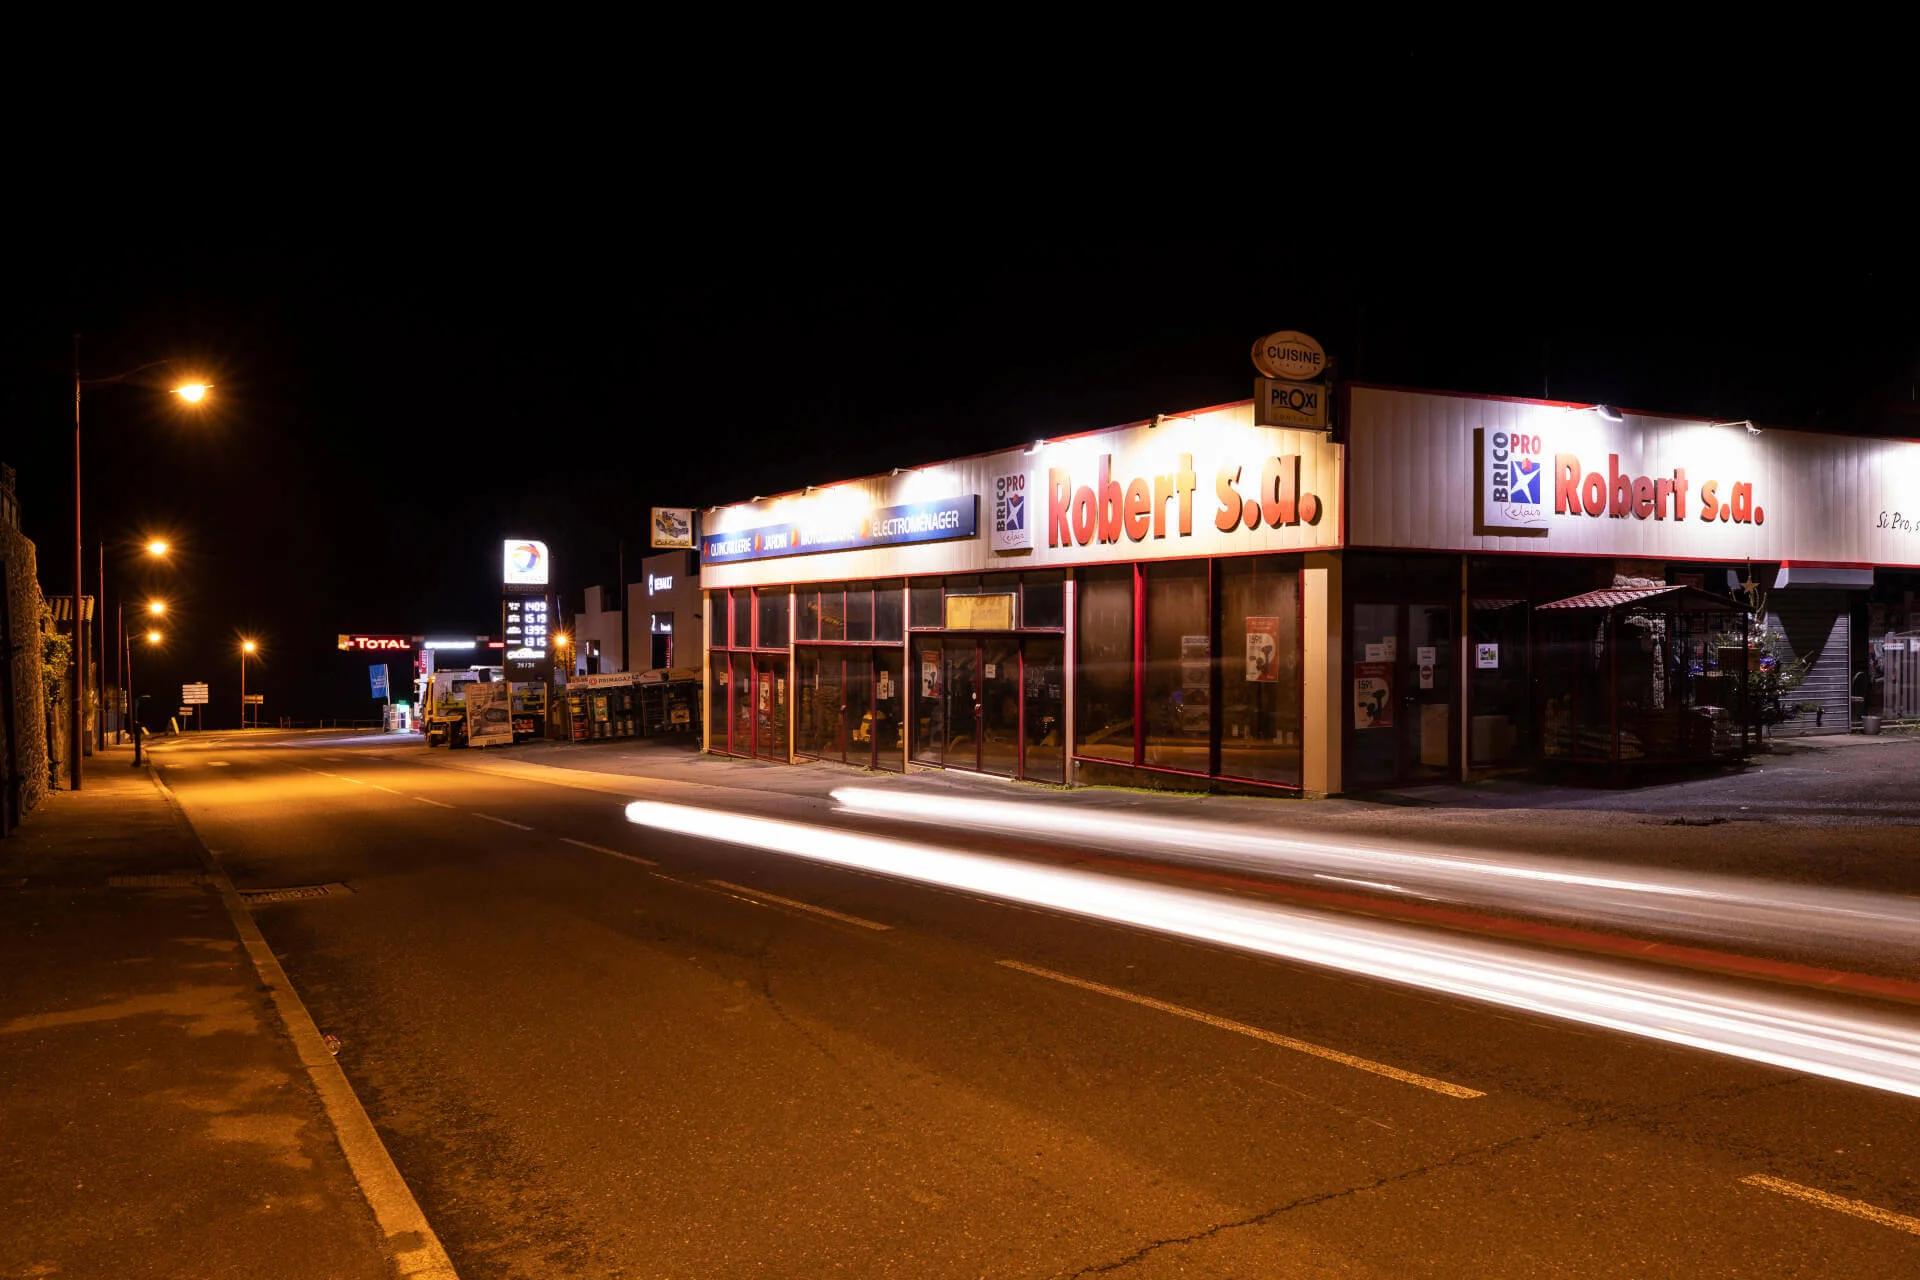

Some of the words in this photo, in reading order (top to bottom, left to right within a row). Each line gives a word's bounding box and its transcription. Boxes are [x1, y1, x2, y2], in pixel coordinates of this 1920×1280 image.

[1267, 346, 1321, 365] CUISINE
[1271, 388, 1318, 410] PROXI
[1510, 433, 1542, 455] PRO
[1493, 432, 1508, 502] BRICO
[1006, 474, 1025, 492] PRO
[1554, 453, 1689, 522] Robert
[1701, 480, 1765, 525] s.a.
[997, 477, 1006, 532] BRICO
[1048, 453, 1197, 548] Robert
[1214, 454, 1323, 533] s.a.
[1876, 511, 1890, 529] Si
[1891, 511, 1912, 533] Pro,
[763, 532, 787, 550] JARDIN
[355, 637, 410, 649] TOTAL
